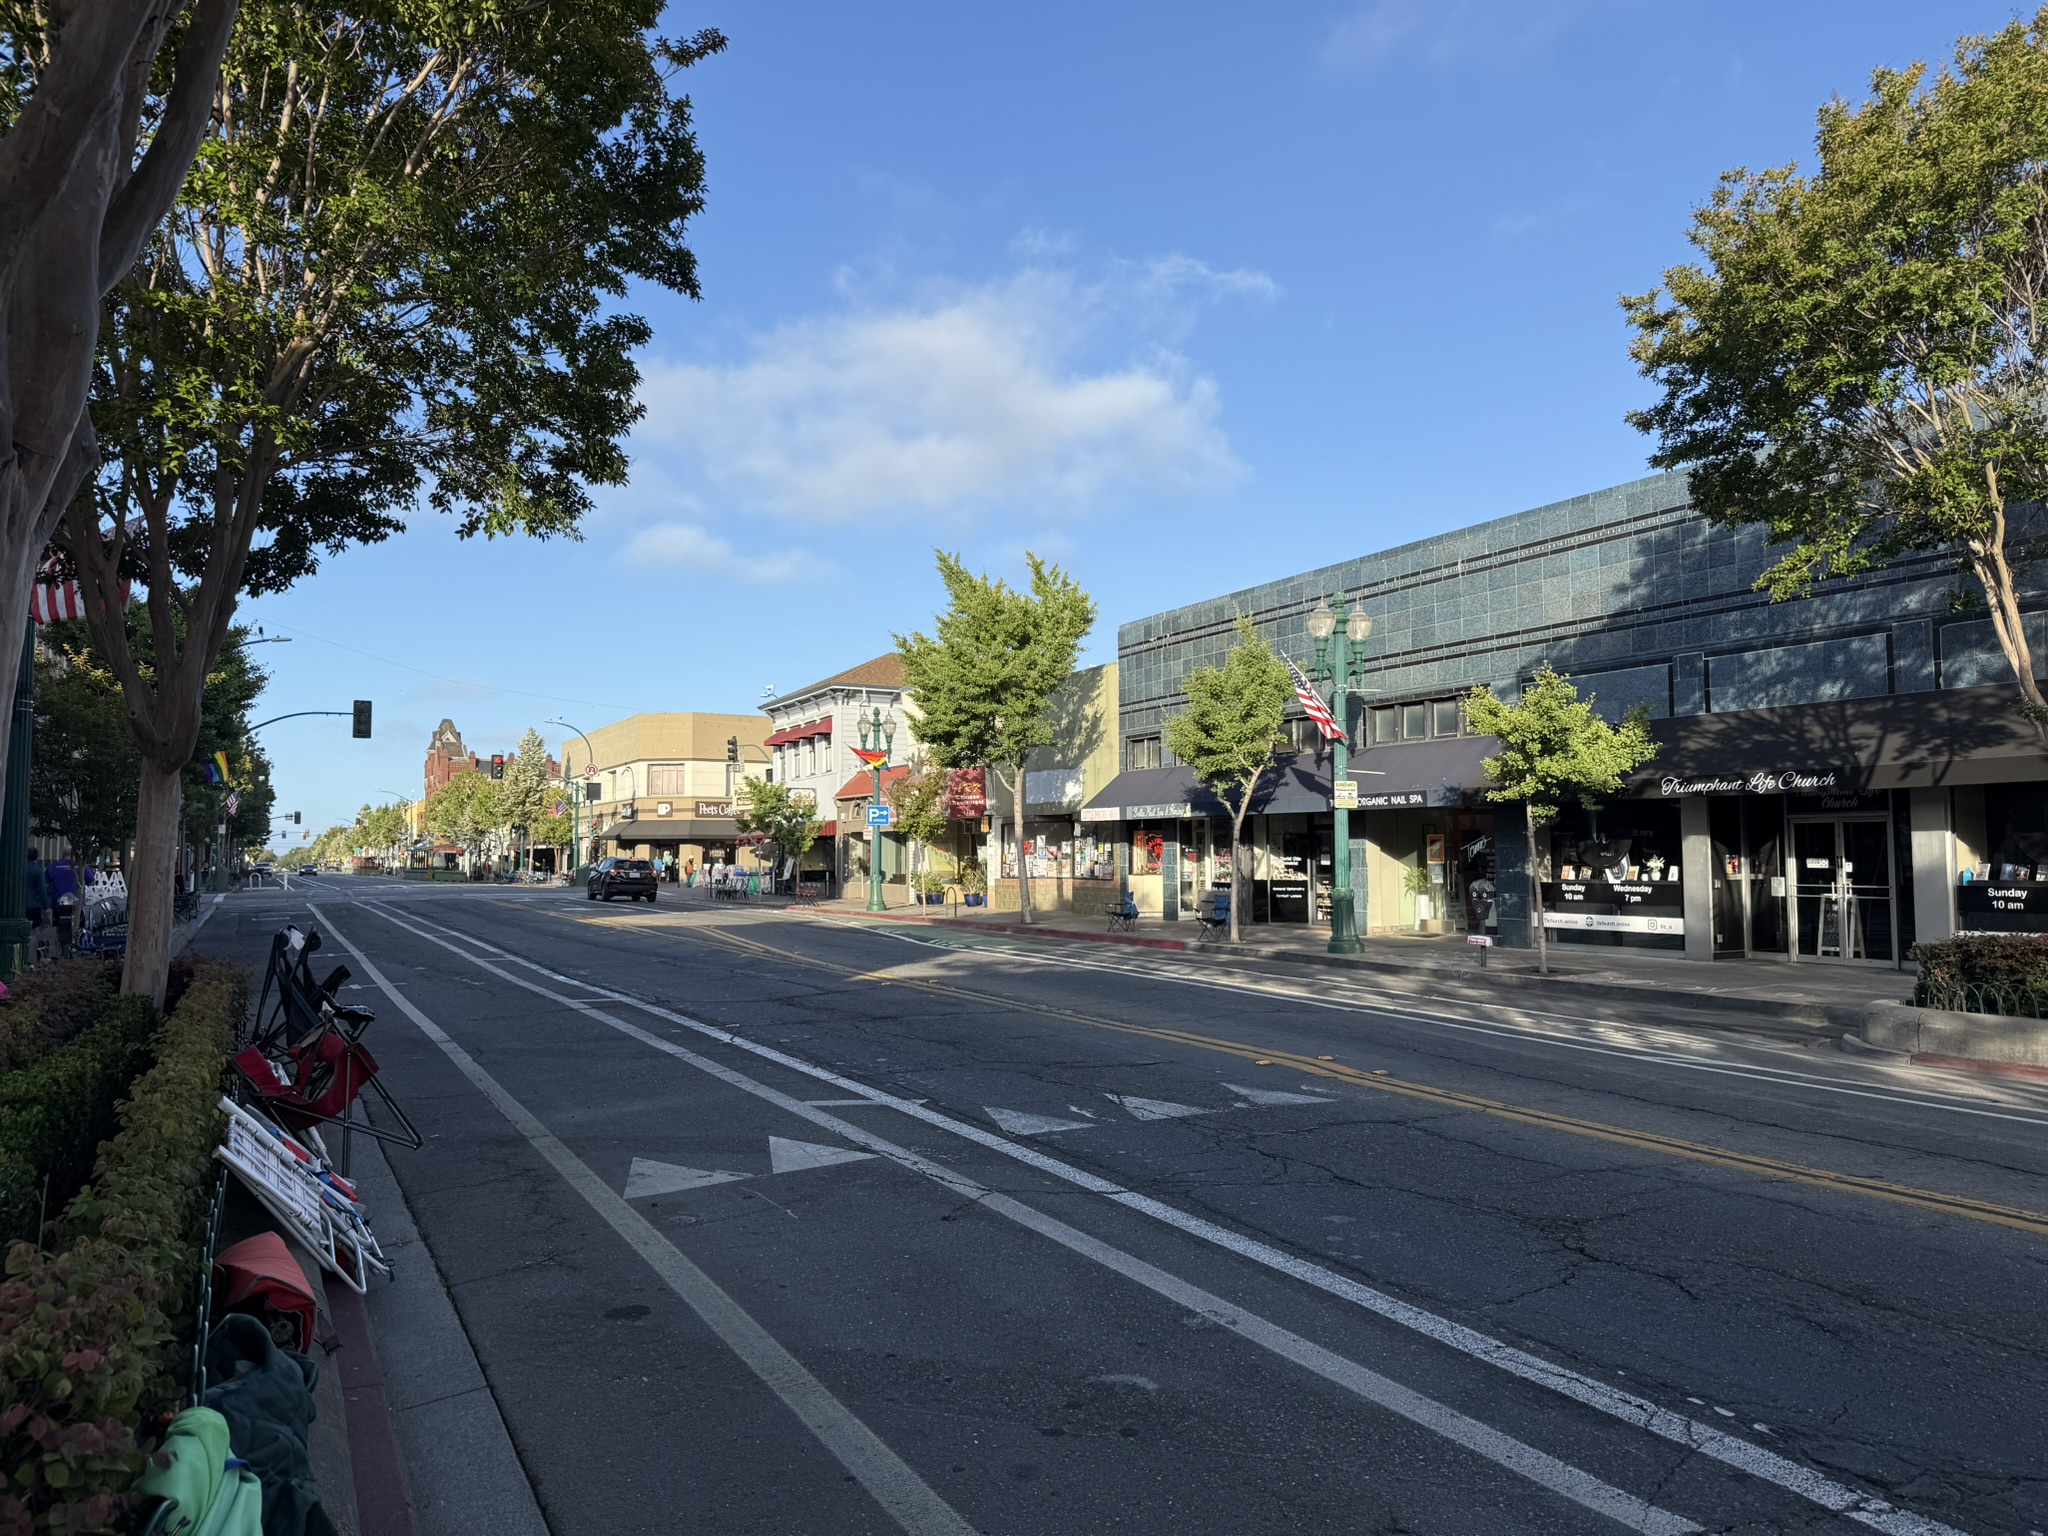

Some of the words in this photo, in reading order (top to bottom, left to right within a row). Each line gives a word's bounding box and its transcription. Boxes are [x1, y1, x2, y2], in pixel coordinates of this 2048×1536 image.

[1661, 776, 1743, 795] Triumphant
[1745, 772, 1776, 794] Life
[1778, 771, 1837, 789] Church
[1357, 798, 1388, 806] ORGANIC
[1391, 796, 1407, 804] NAIL
[1409, 795, 1423, 804] SPA
[1822, 796, 1859, 808] Church
[698, 803, 718, 815] Peet's
[1562, 883, 1585, 892] Sunday
[1613, 884, 1652, 894] Wednesday
[1988, 888, 2027, 899] Sunday
[1992, 900, 2005, 909] 10
[2008, 902, 2024, 910] am
